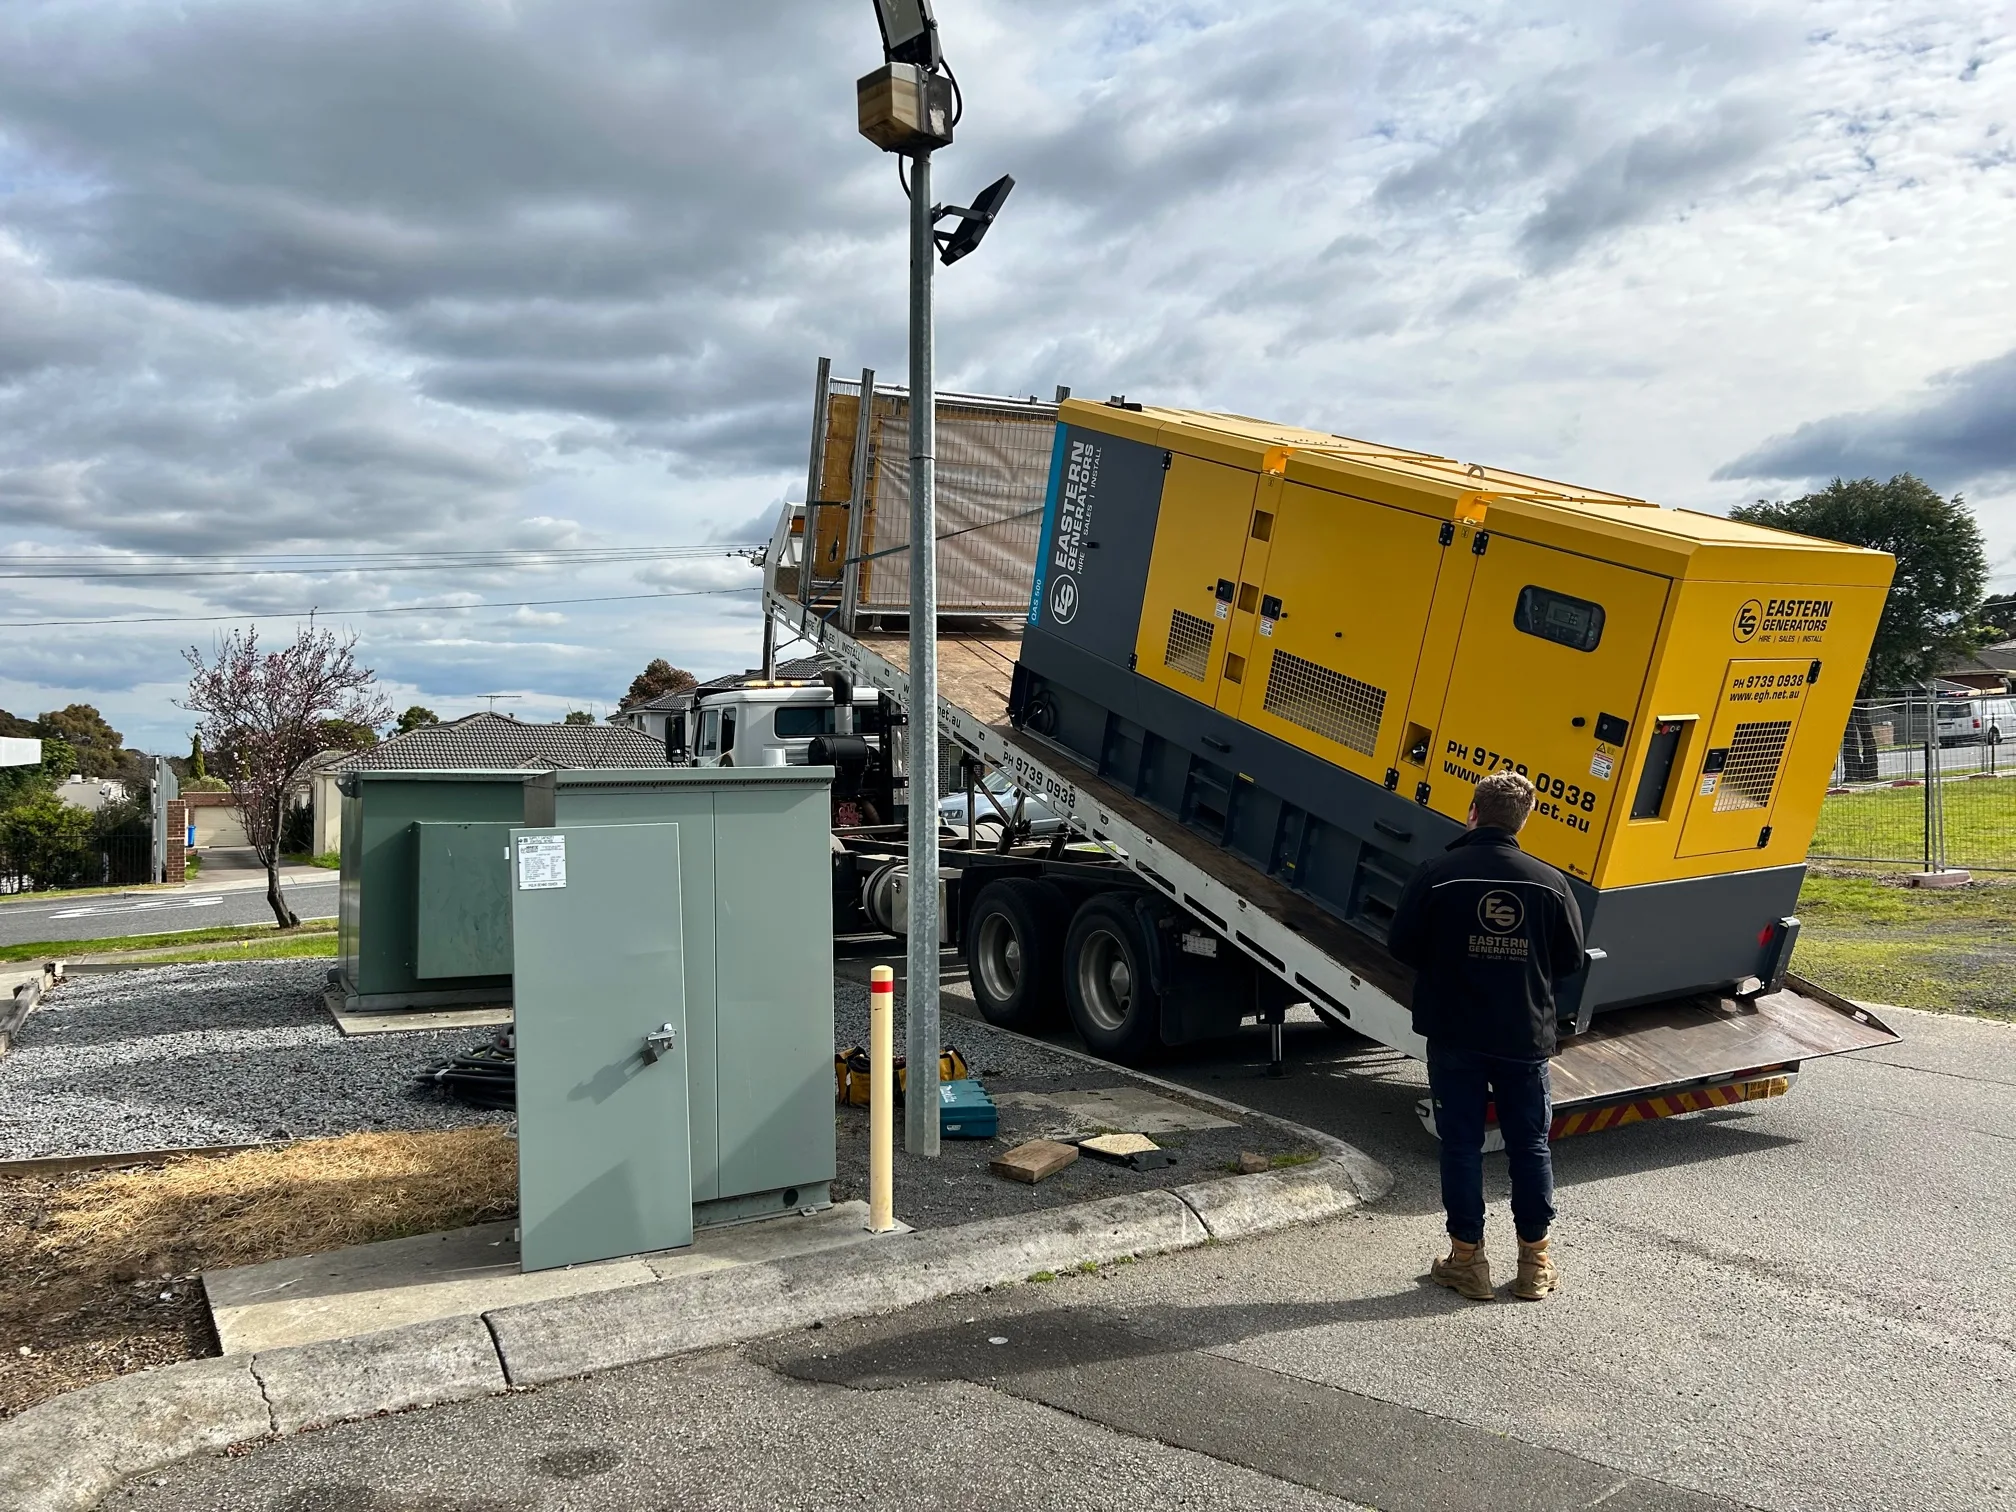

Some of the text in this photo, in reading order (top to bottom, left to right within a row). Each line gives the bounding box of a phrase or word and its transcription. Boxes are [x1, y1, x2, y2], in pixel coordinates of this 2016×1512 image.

[1055, 440, 1084, 568] EASTERN
[1067, 443, 1094, 571] GENERATORS
[1077, 447, 1102, 575] HIRE SALES INSTALL
[1766, 599, 1833, 618] EASTERN
[1762, 619, 1828, 632] GENERATORS
[1758, 635, 1823, 643] HIRE SALES INSTALL
[841, 641, 861, 662] INSTALL
[1733, 674, 1804, 689] PH 9739 0938
[1729, 689, 1800, 704] www.egh.net.au
[1003, 751, 1076, 809] PH 9739 0938
[1446, 740, 1468, 760] PH
[1535, 772, 1596, 812] 0938
[1468, 945, 1529, 956] GENERATORS
[1469, 935, 1529, 949] EASTERN
